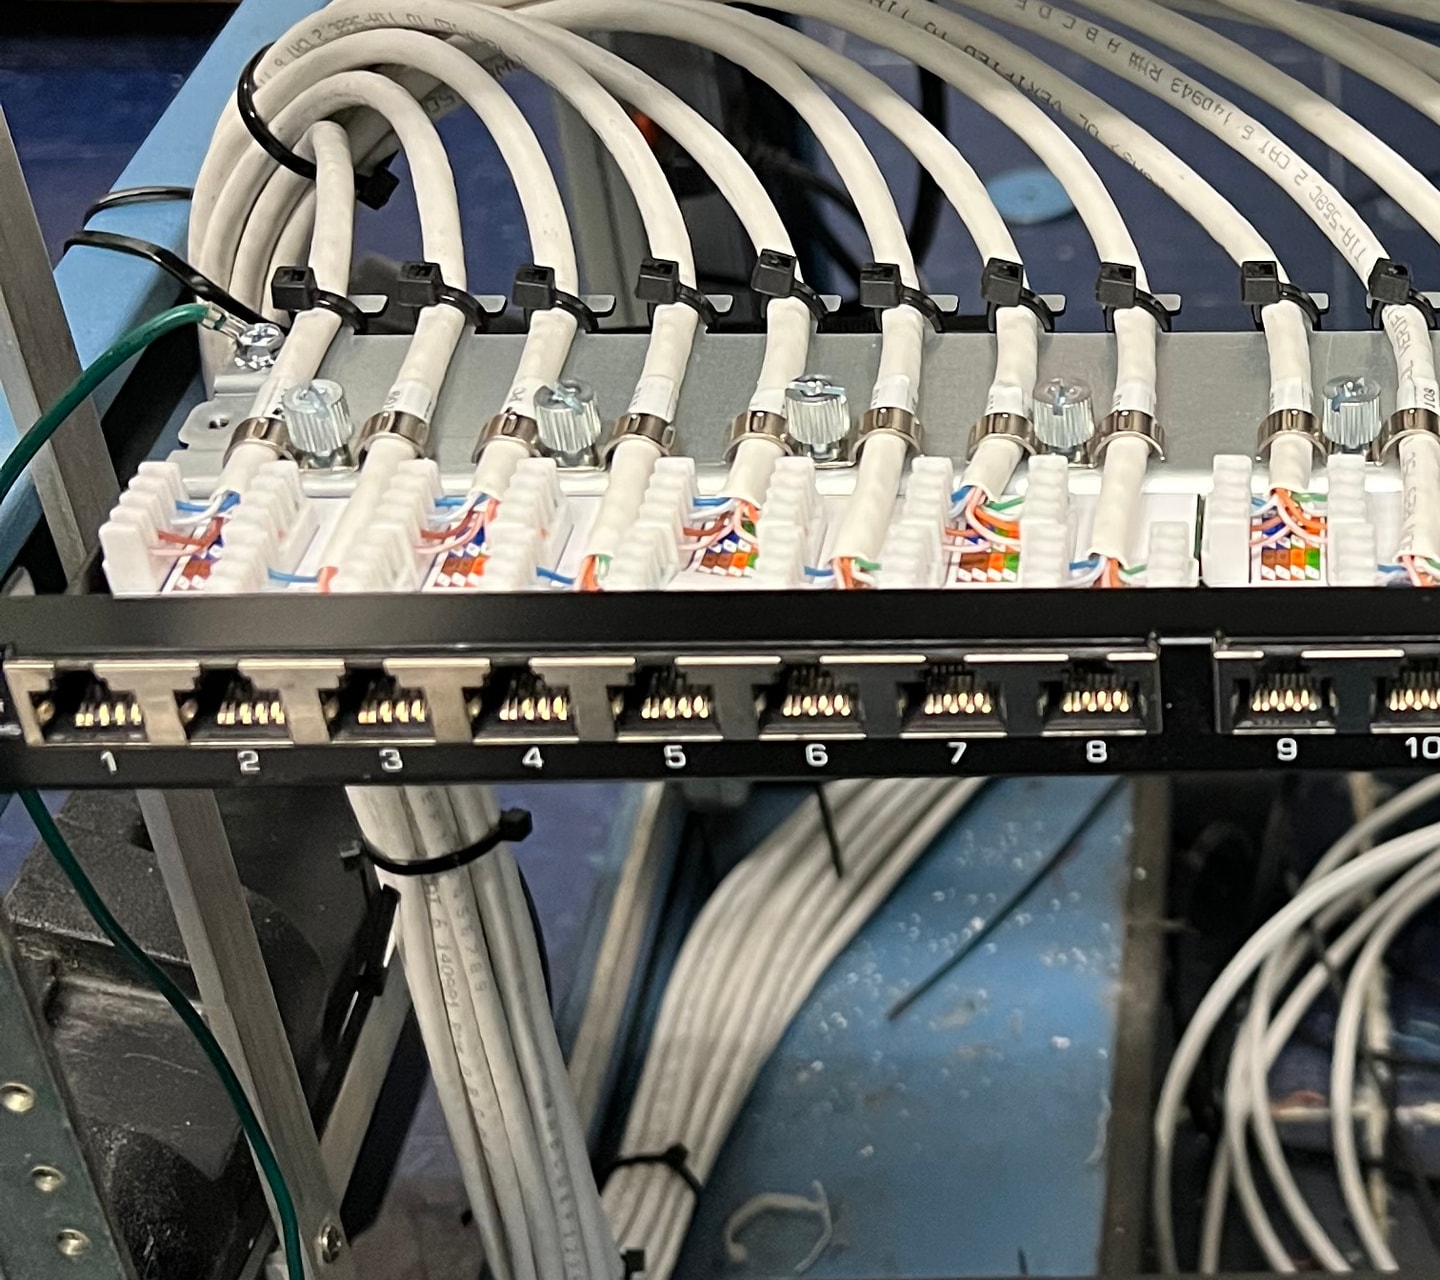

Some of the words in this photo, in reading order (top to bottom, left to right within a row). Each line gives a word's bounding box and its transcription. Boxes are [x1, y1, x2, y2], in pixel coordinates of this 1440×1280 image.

[1038, 6, 1054, 22] D
[1169, 76, 1233, 127] 140943
[1078, 113, 1101, 139] UL
[1240, 122, 1256, 141] 6
[1254, 138, 1293, 170] CAT
[1422, 387, 1437, 410] 108
[237, 749, 261, 772] 2
[379, 748, 403, 771] 3
[522, 746, 544, 768] 4
[663, 744, 687, 768] 5
[805, 743, 829, 766] 6
[948, 741, 967, 764] 7
[1086, 739, 1108, 763] 8
[1276, 737, 1298, 761] 9
[100, 750, 117, 773] 1
